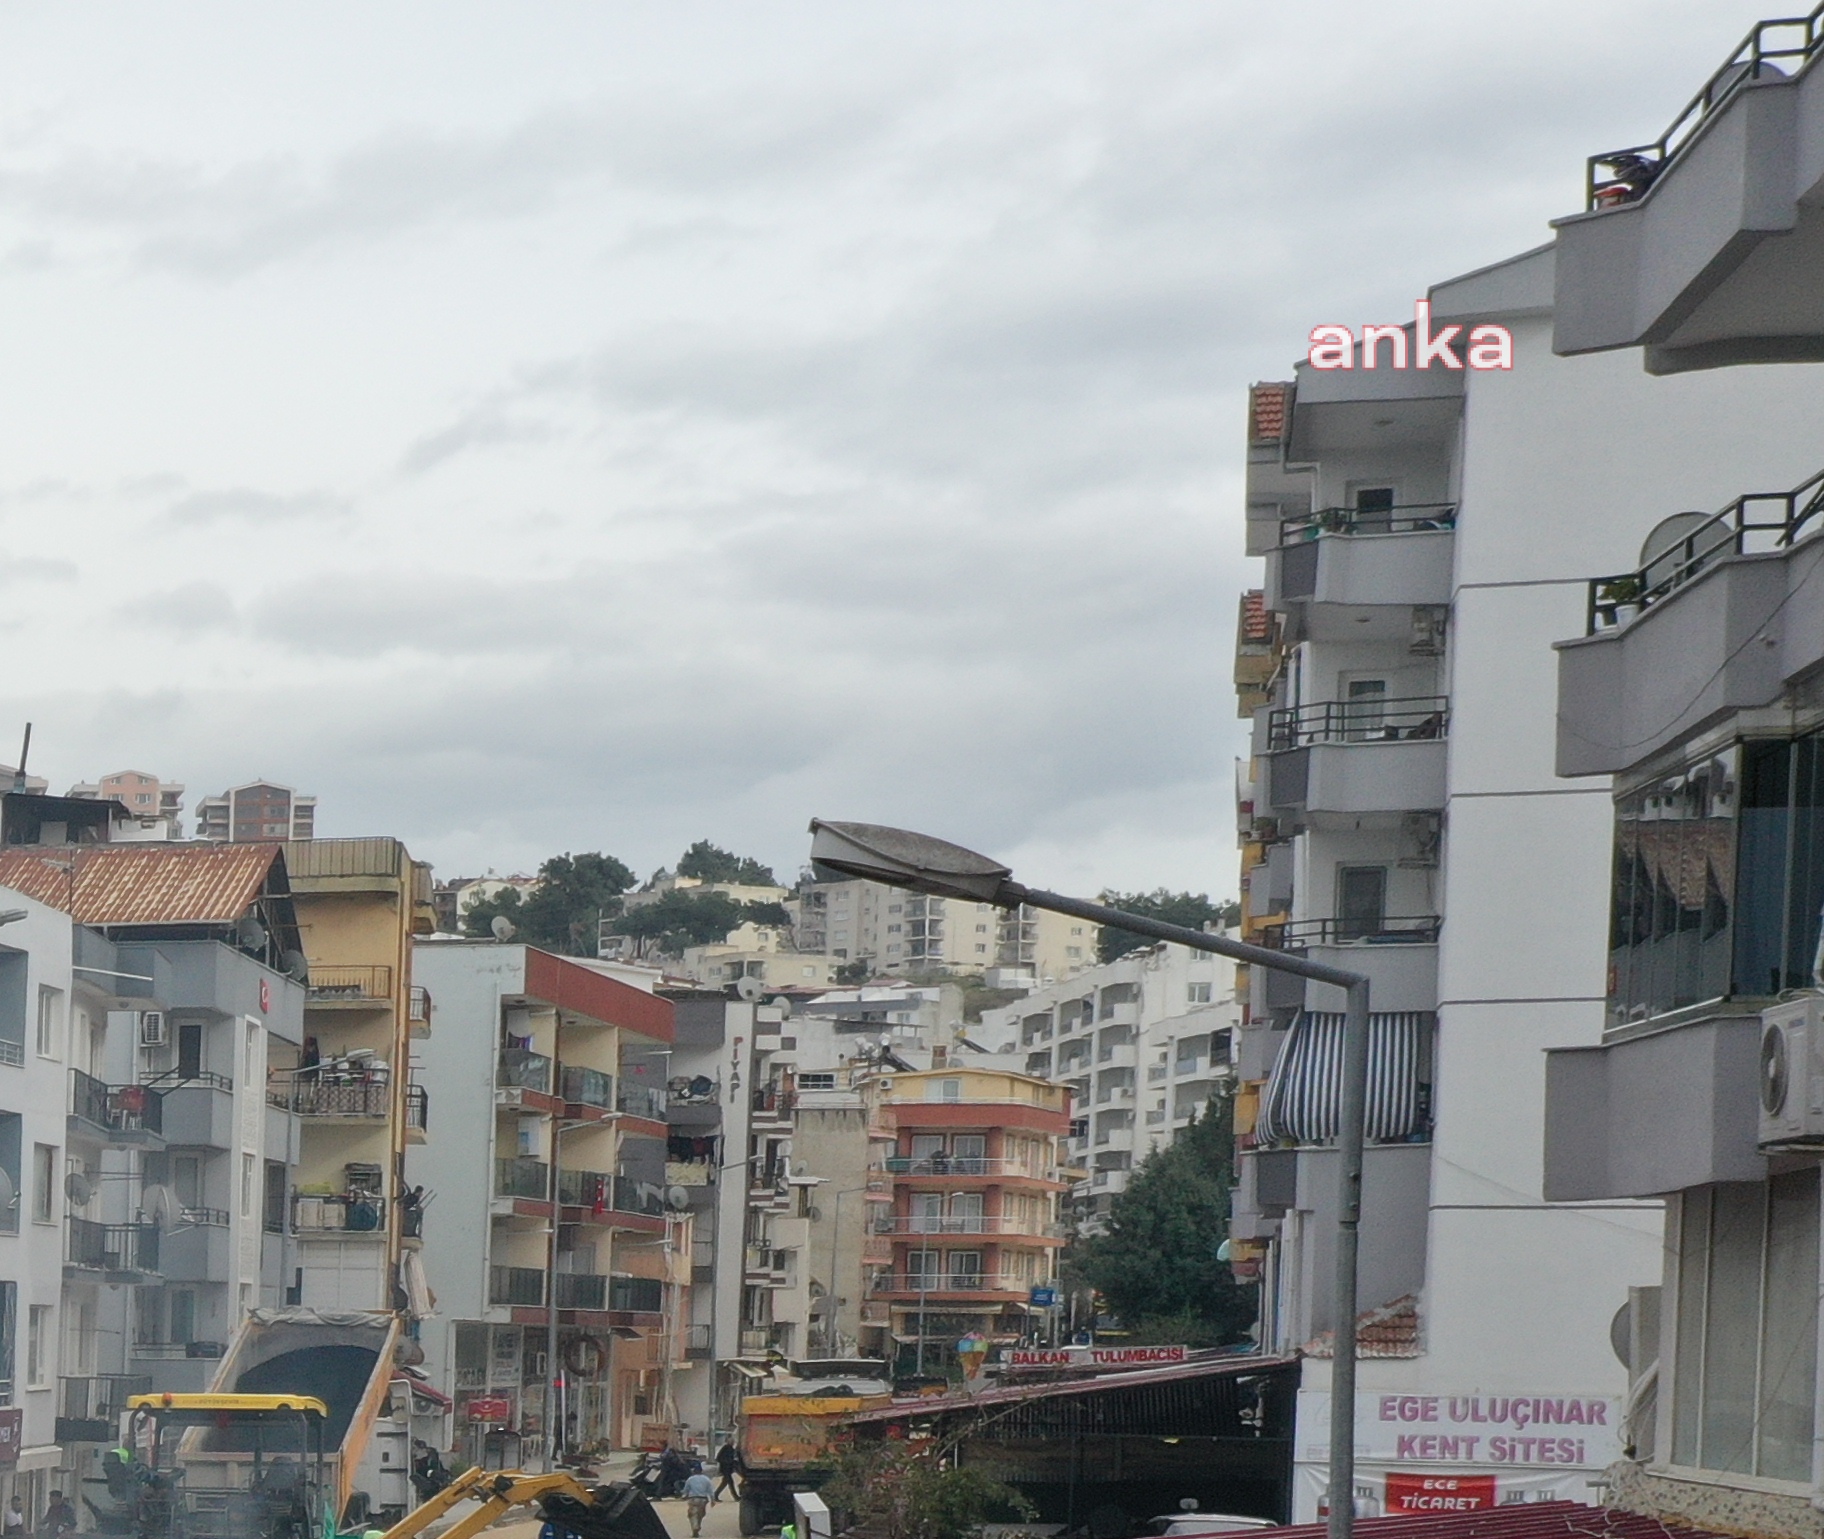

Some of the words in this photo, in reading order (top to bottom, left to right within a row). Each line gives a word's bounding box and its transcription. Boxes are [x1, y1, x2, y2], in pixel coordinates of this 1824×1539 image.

[1011, 1351, 1070, 1365] BALKAN
[1090, 1346, 1184, 1363] TULUMBACISI
[1378, 1395, 1439, 1423] EGE
[1448, 1397, 1608, 1430] ULUÇINAR
[1396, 1434, 1478, 1461] KENT
